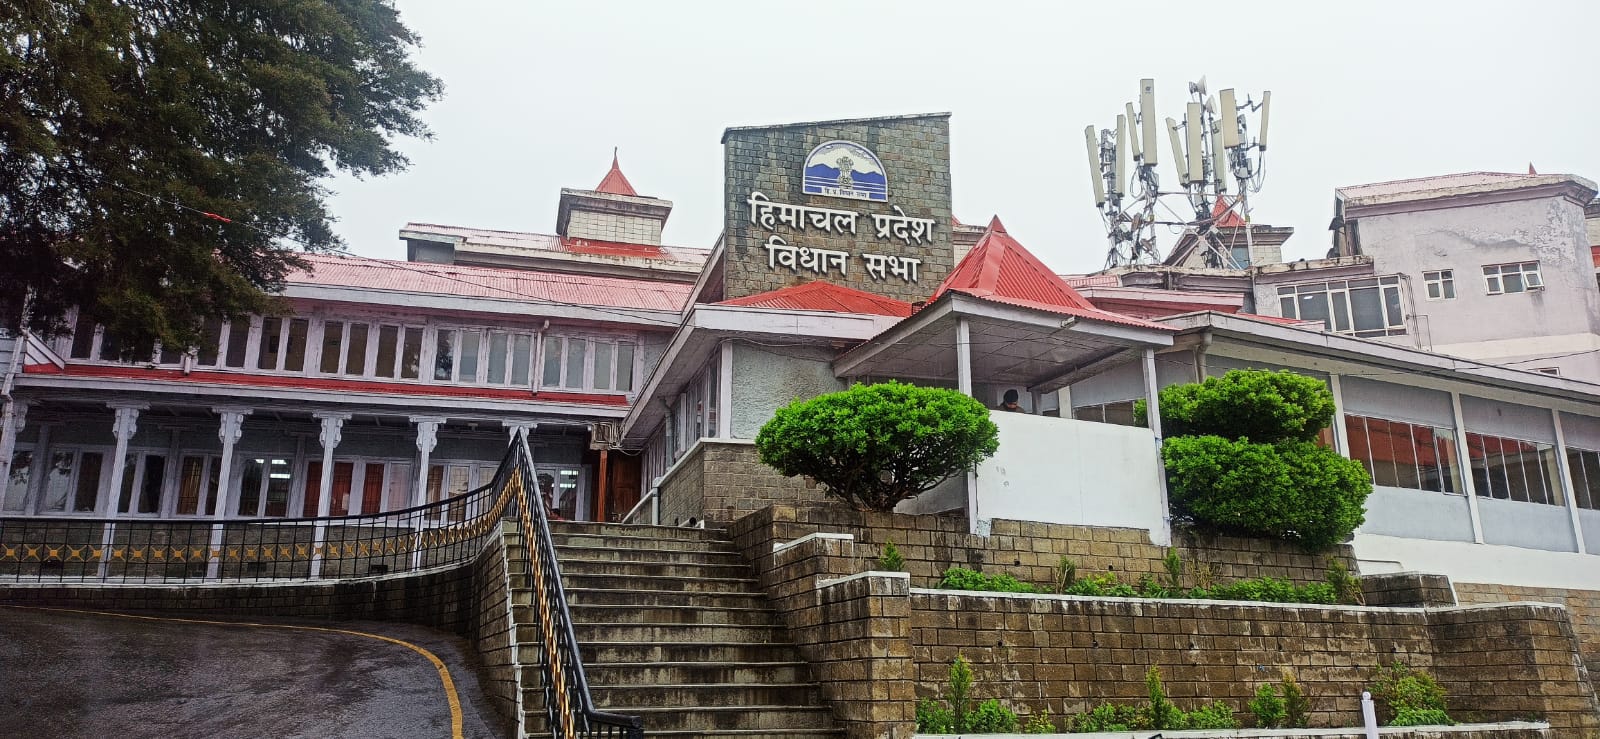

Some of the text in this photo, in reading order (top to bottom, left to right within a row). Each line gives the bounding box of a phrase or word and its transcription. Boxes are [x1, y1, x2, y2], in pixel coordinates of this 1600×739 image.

[747, 191, 935, 244] हिमाचल प्रदेश
[764, 235, 921, 282] विधान सभा
